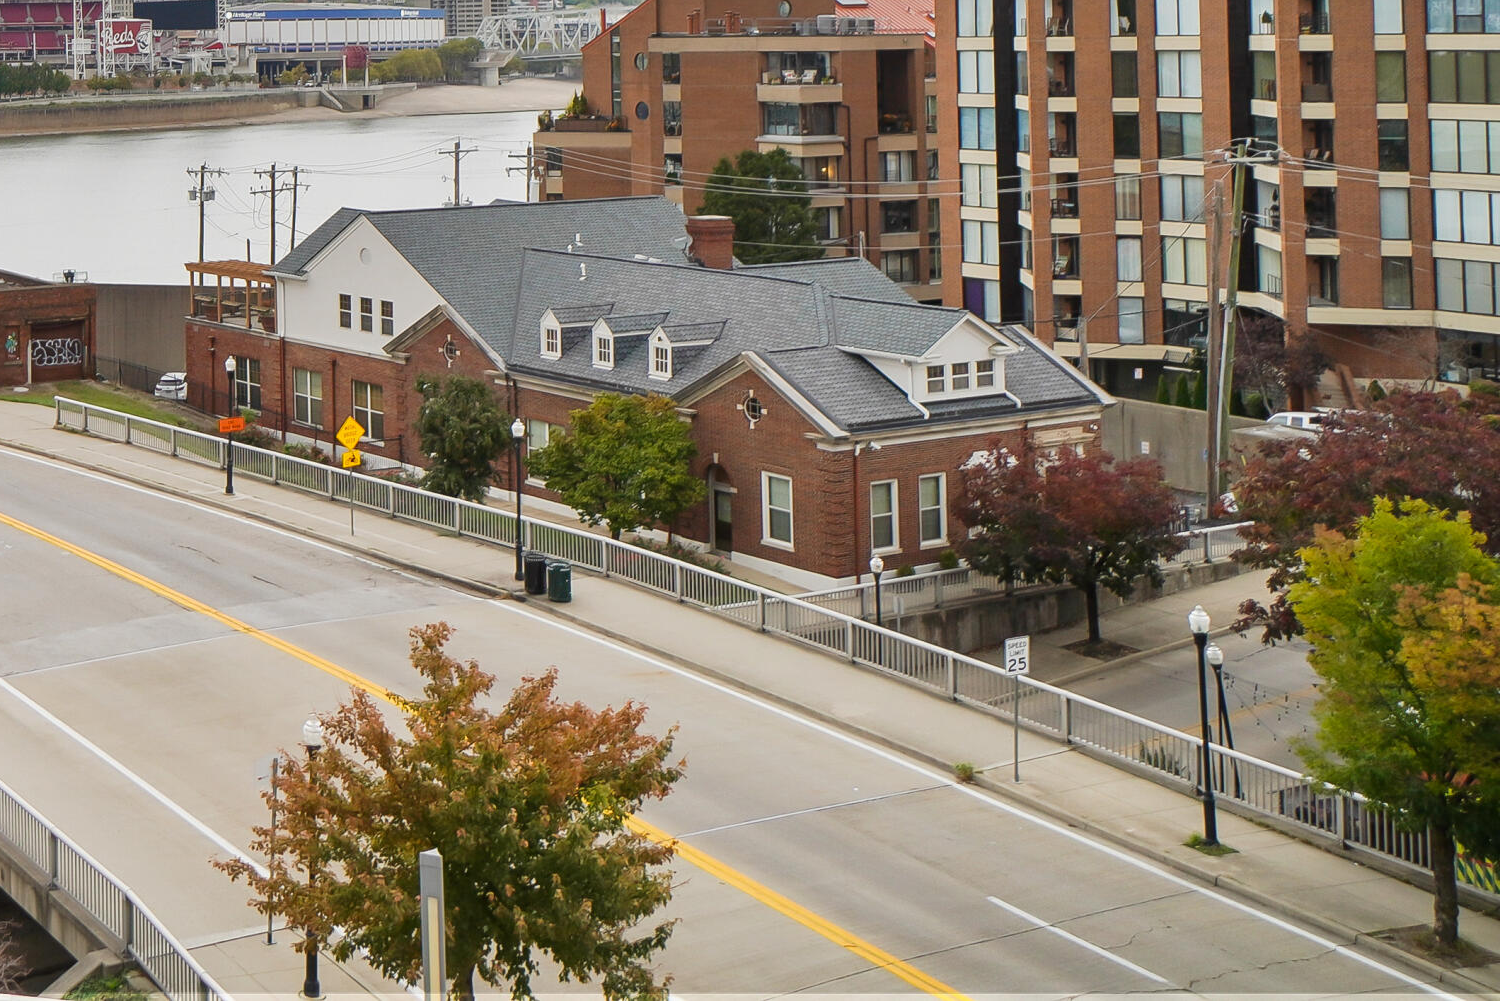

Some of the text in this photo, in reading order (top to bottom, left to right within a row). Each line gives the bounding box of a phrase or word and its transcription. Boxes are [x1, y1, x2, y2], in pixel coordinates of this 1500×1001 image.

[100, 24, 135, 51] Reds
[1008, 641, 1027, 650] SPEED
[1009, 649, 1026, 657] LIMIT
[1008, 656, 1027, 673] 25
